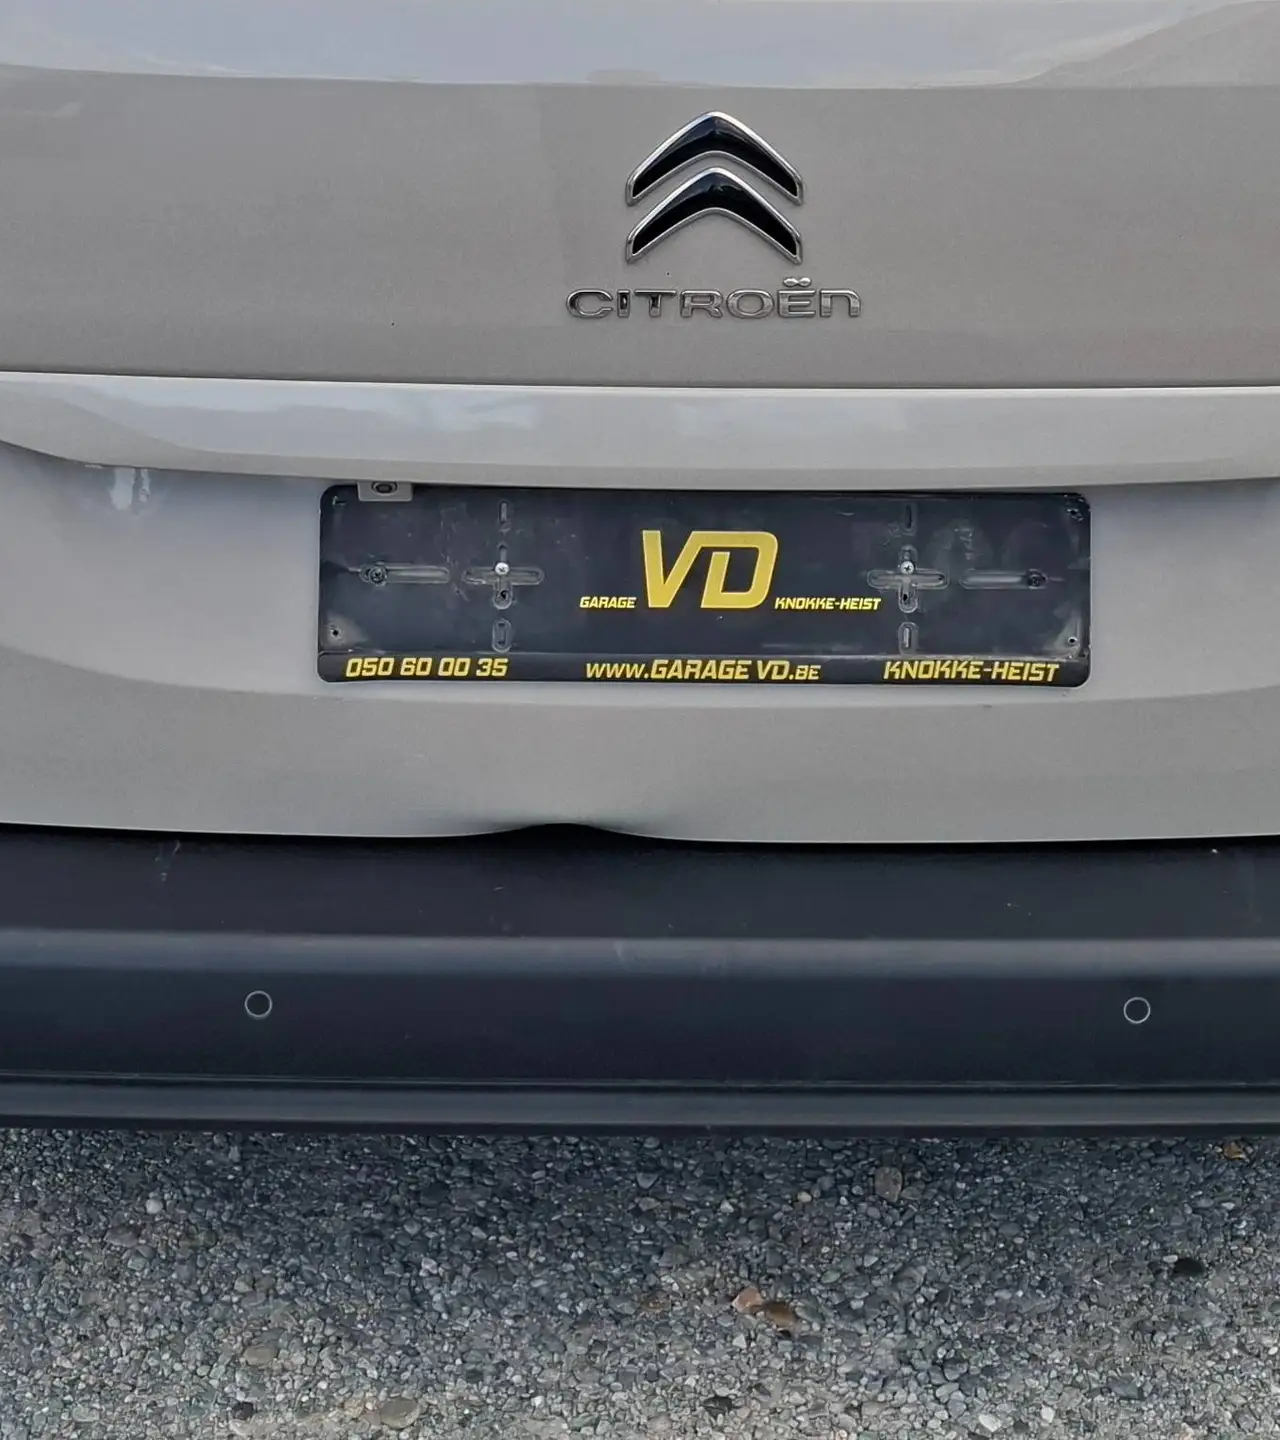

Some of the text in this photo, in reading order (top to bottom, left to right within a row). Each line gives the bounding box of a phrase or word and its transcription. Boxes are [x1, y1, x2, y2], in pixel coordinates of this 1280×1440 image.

[579, 529, 881, 611] GARAGE VD KNOKKE-HEIST
[345, 657, 509, 678] 050 60 00 35
[883, 660, 1059, 683] KNOKKE-HEIST
